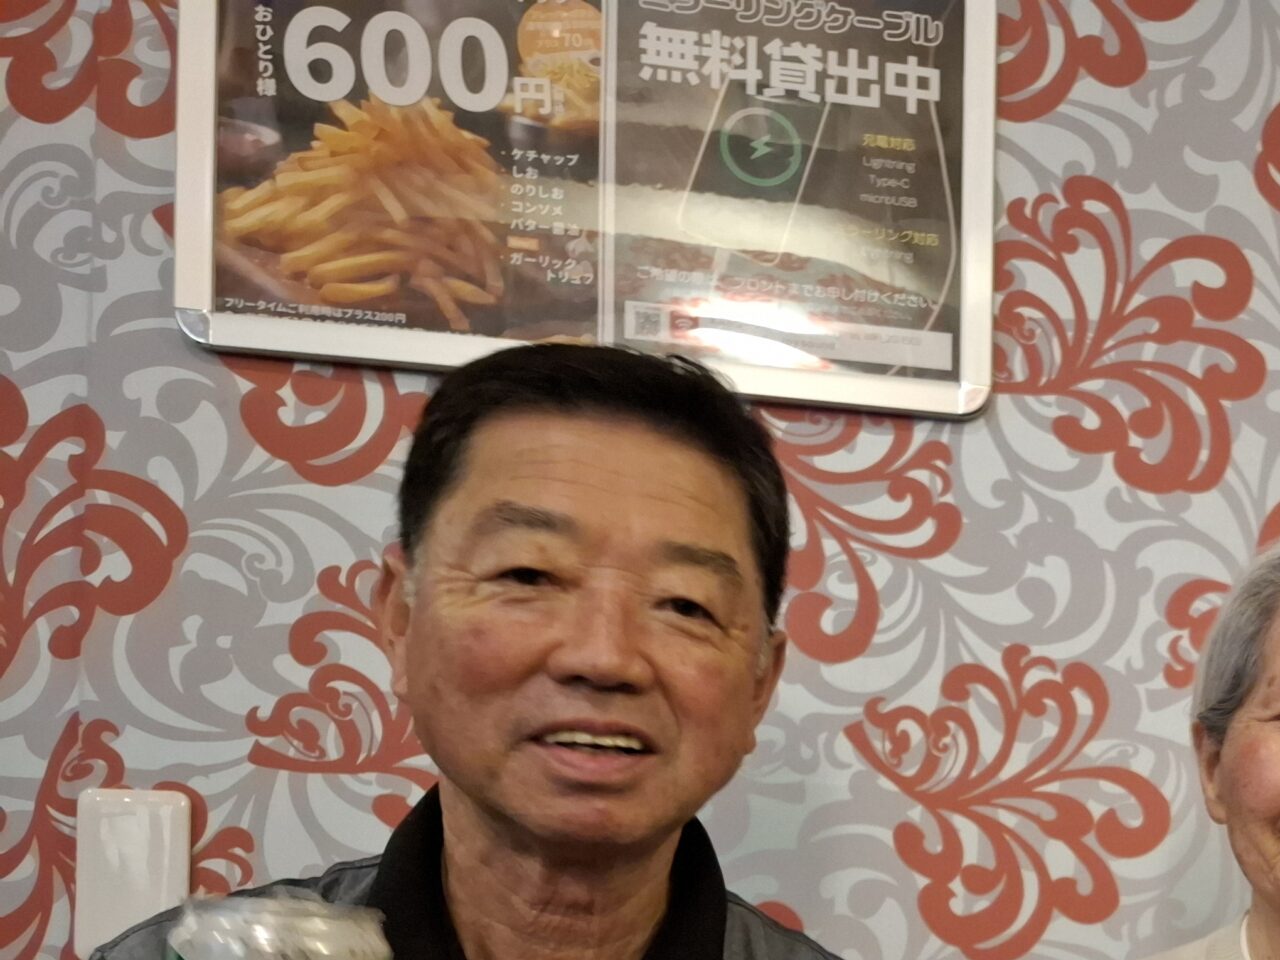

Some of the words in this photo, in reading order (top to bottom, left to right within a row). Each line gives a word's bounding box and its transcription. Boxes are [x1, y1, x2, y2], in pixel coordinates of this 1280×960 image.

[254, 4, 277, 97] おひとり様
[638, 20, 941, 114] 無料貸出中
[511, 148, 579, 166] ケチャップ
[512, 166, 538, 179] しお
[510, 184, 564, 200] のりしお
[511, 201, 563, 216] コンソメ
[510, 252, 577, 269] ガーリック
